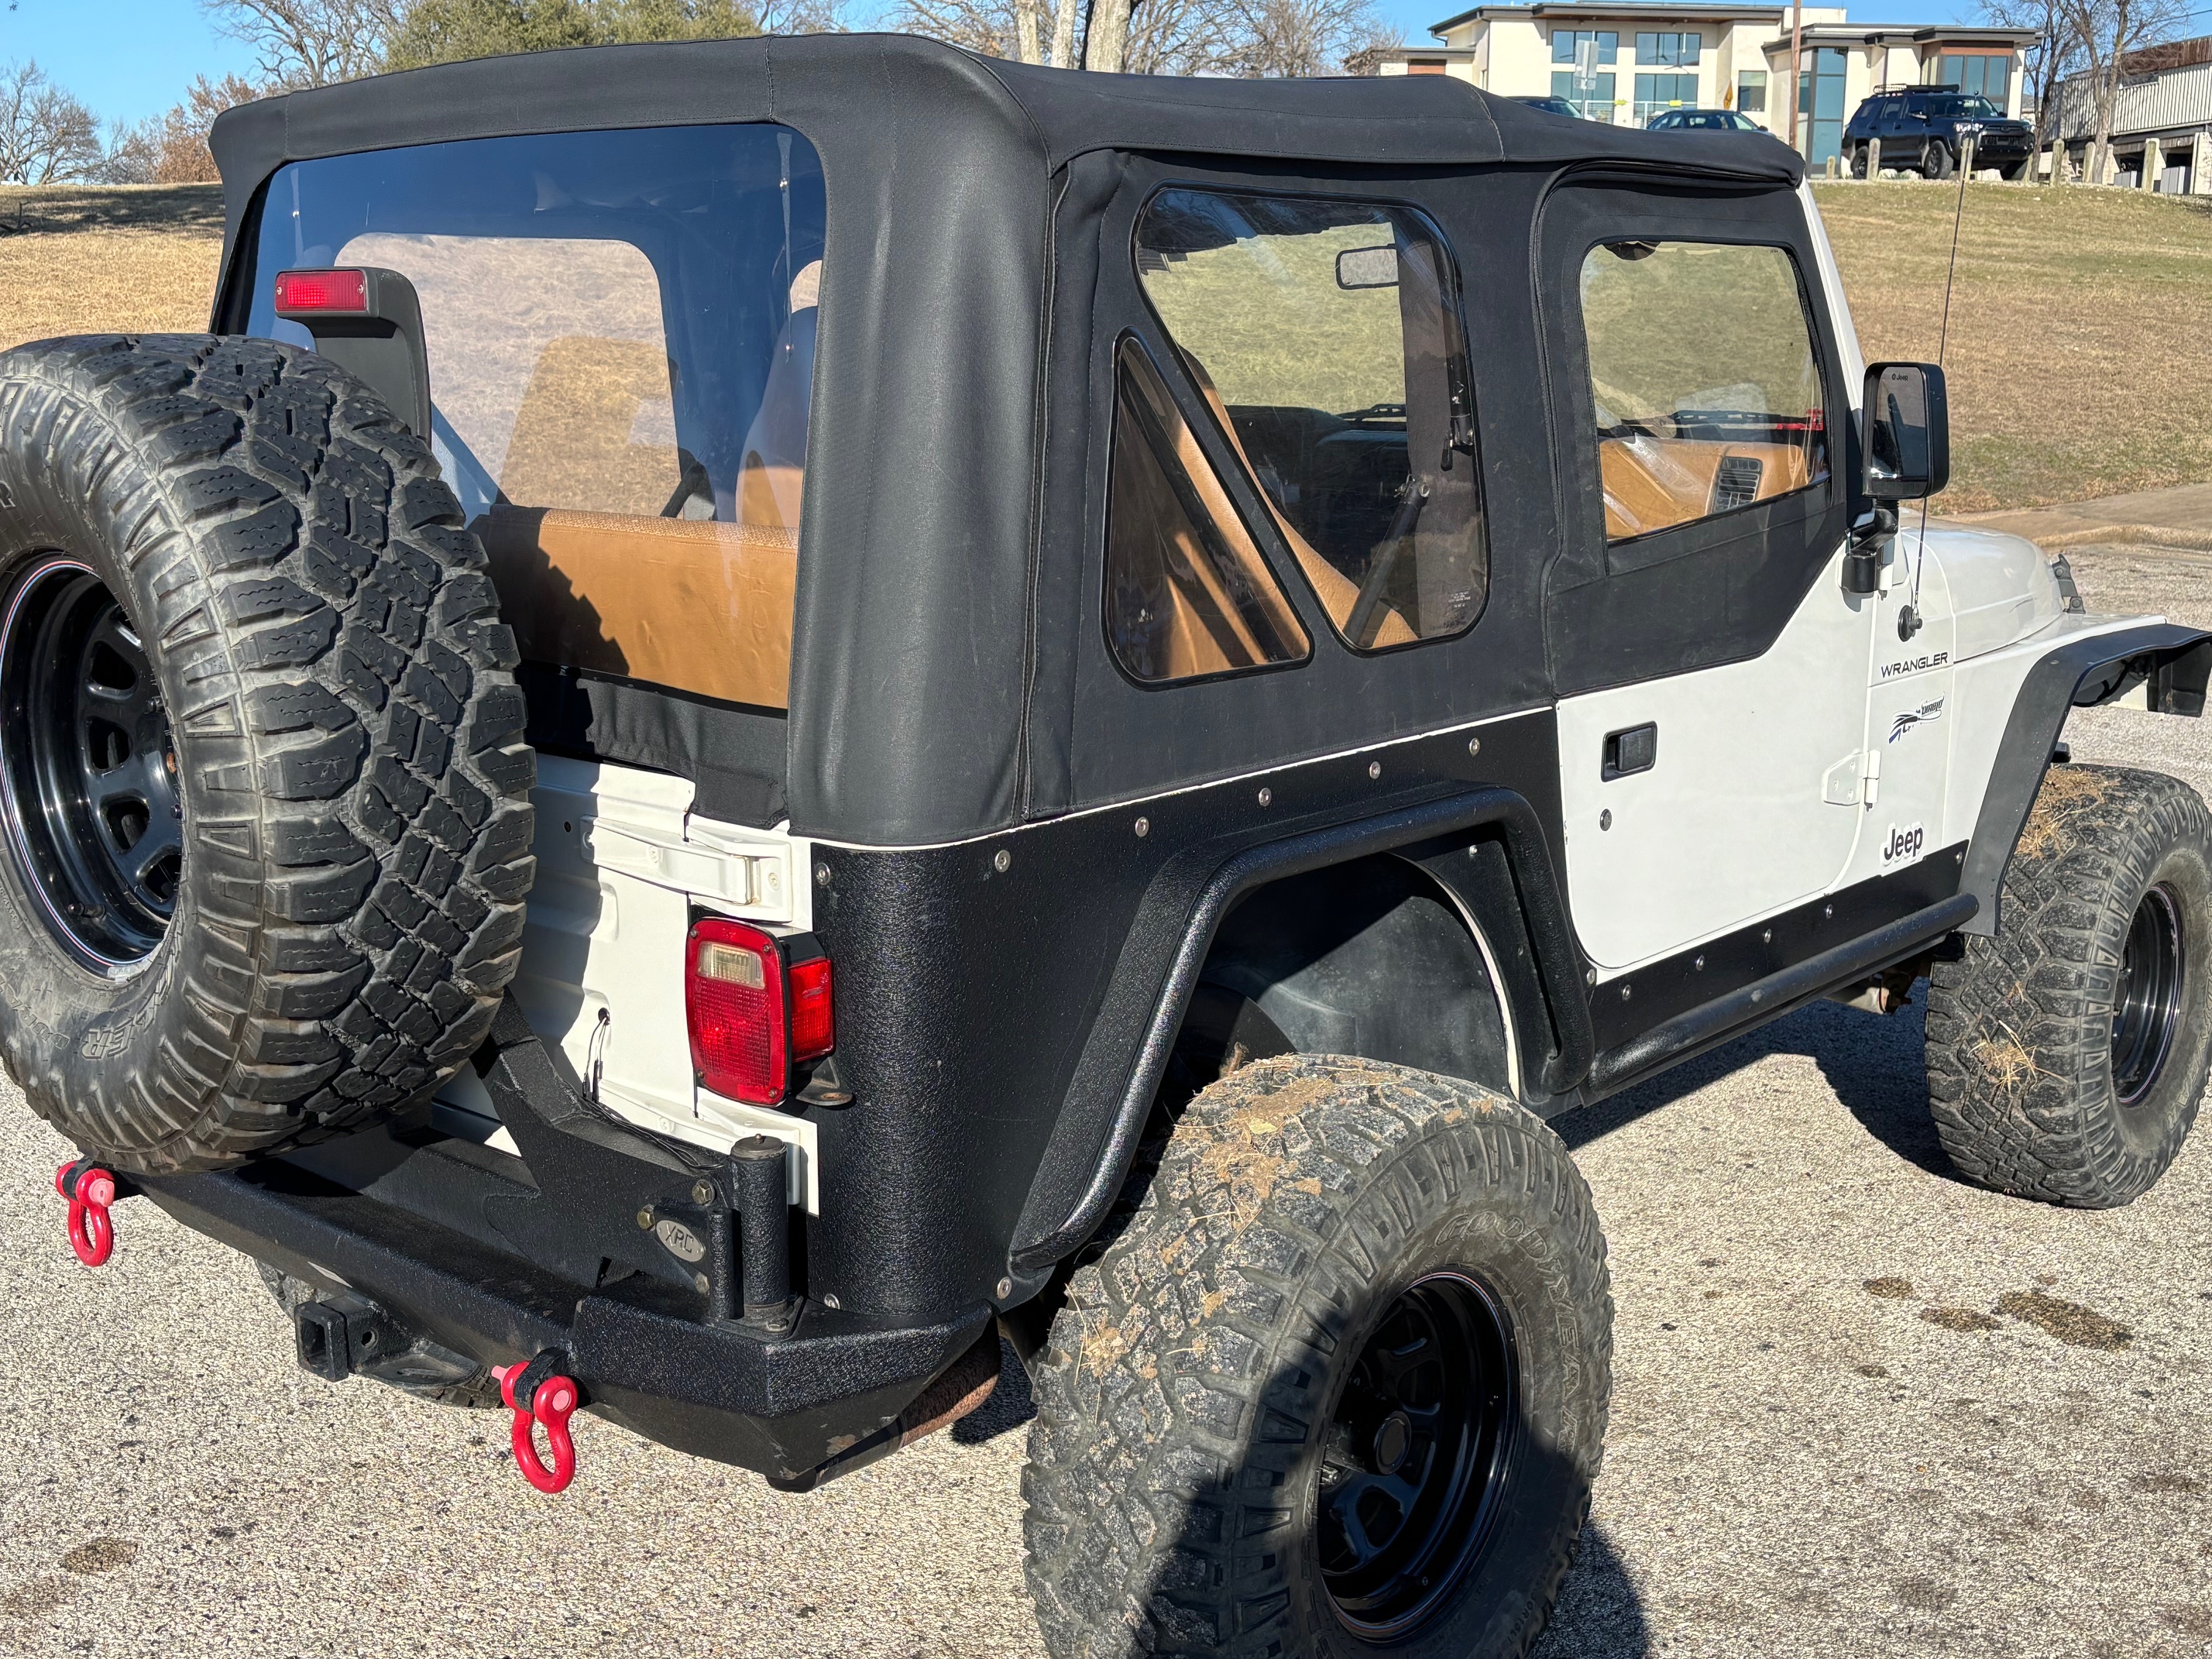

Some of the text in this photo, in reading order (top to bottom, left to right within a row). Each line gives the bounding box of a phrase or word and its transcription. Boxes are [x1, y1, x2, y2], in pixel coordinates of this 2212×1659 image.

[1881, 651, 1949, 678] WRANGLER
[1884, 827, 1924, 860] Jeep
[665, 1222, 694, 1254] XRC
